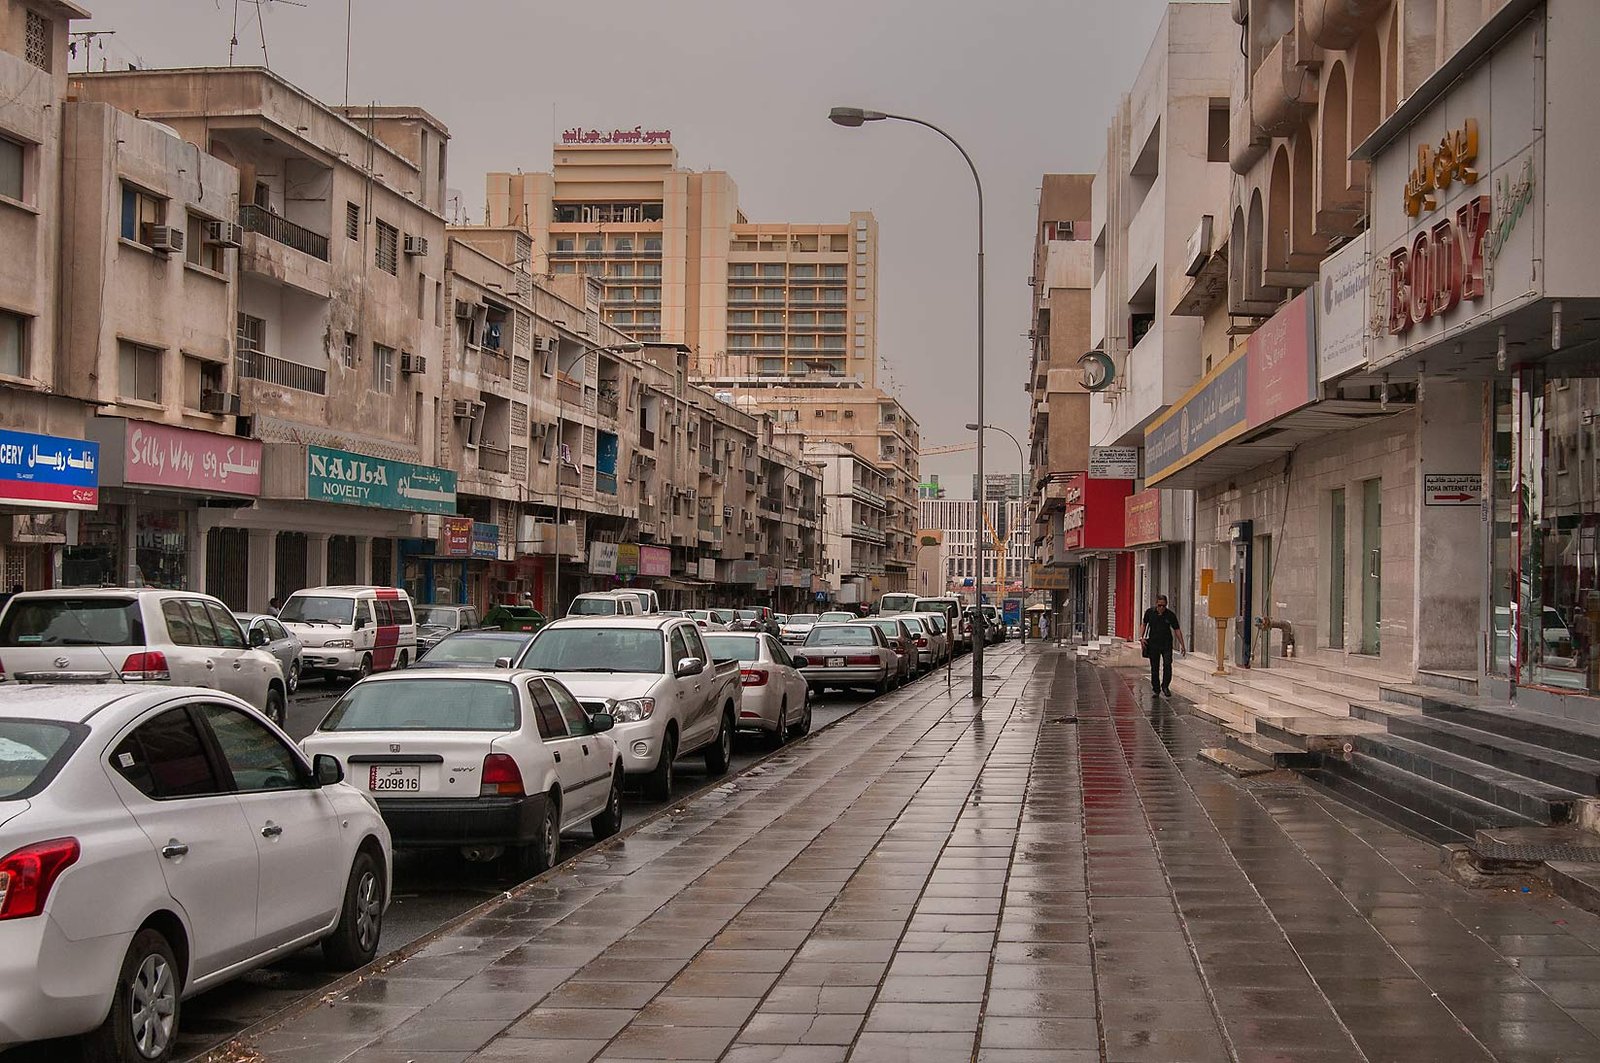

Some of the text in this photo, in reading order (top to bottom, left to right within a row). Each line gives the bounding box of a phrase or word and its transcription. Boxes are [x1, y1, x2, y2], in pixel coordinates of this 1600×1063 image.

[1390, 195, 1491, 335] BODY
[0, 444, 23, 464] CERY
[28, 444, 94, 474] بقالة رويال
[131, 428, 194, 480] Silky Way
[202, 446, 259, 484] سلكي وي
[310, 453, 388, 486] NAJLA
[323, 482, 370, 499] NOVELTY
[378, 778, 418, 789] 209816
[388, 768, 403, 777] قطر
